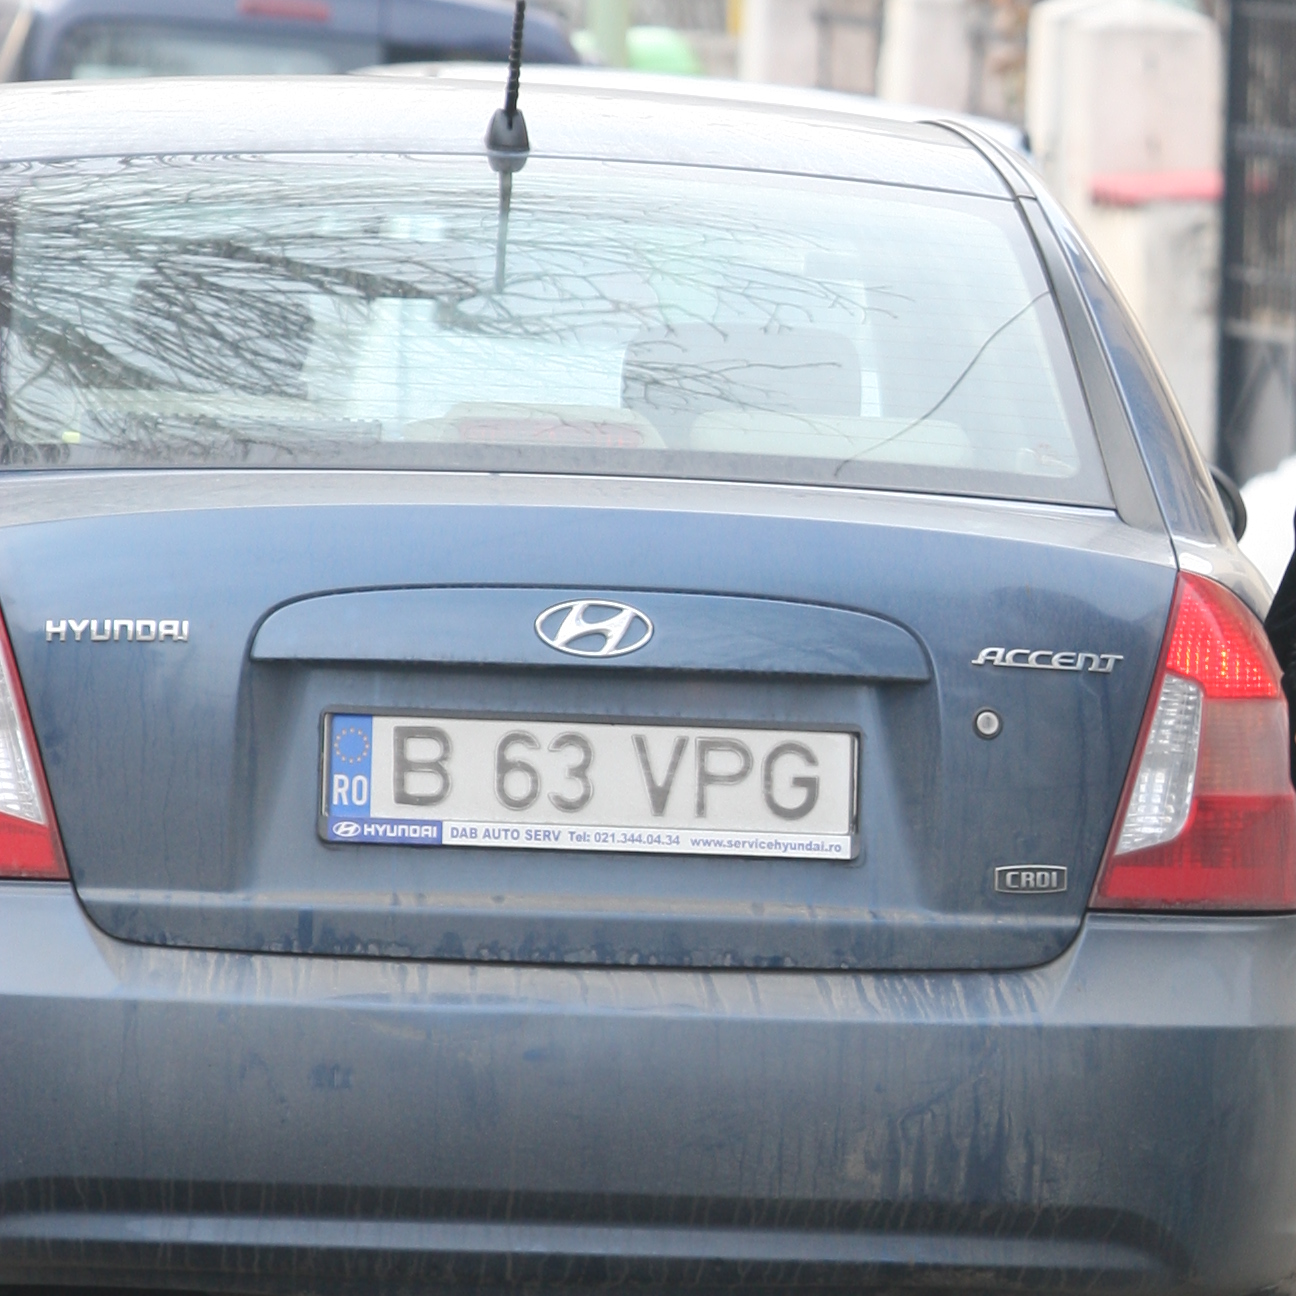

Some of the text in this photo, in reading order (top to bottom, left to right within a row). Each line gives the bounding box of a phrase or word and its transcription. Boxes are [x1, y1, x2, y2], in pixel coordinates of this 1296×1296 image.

[45, 618, 189, 642] HYUNDAI
[971, 647, 1124, 673] ACCENT
[393, 726, 819, 821] B 63 VPG
[333, 774, 368, 806] RO
[363, 823, 437, 839] HYUNDAI
[450, 826, 842, 853] DAB AUTO SERV Tel: 021.344.04.34 www.servicehyundai.ro
[1005, 871, 1057, 888] CRDI
